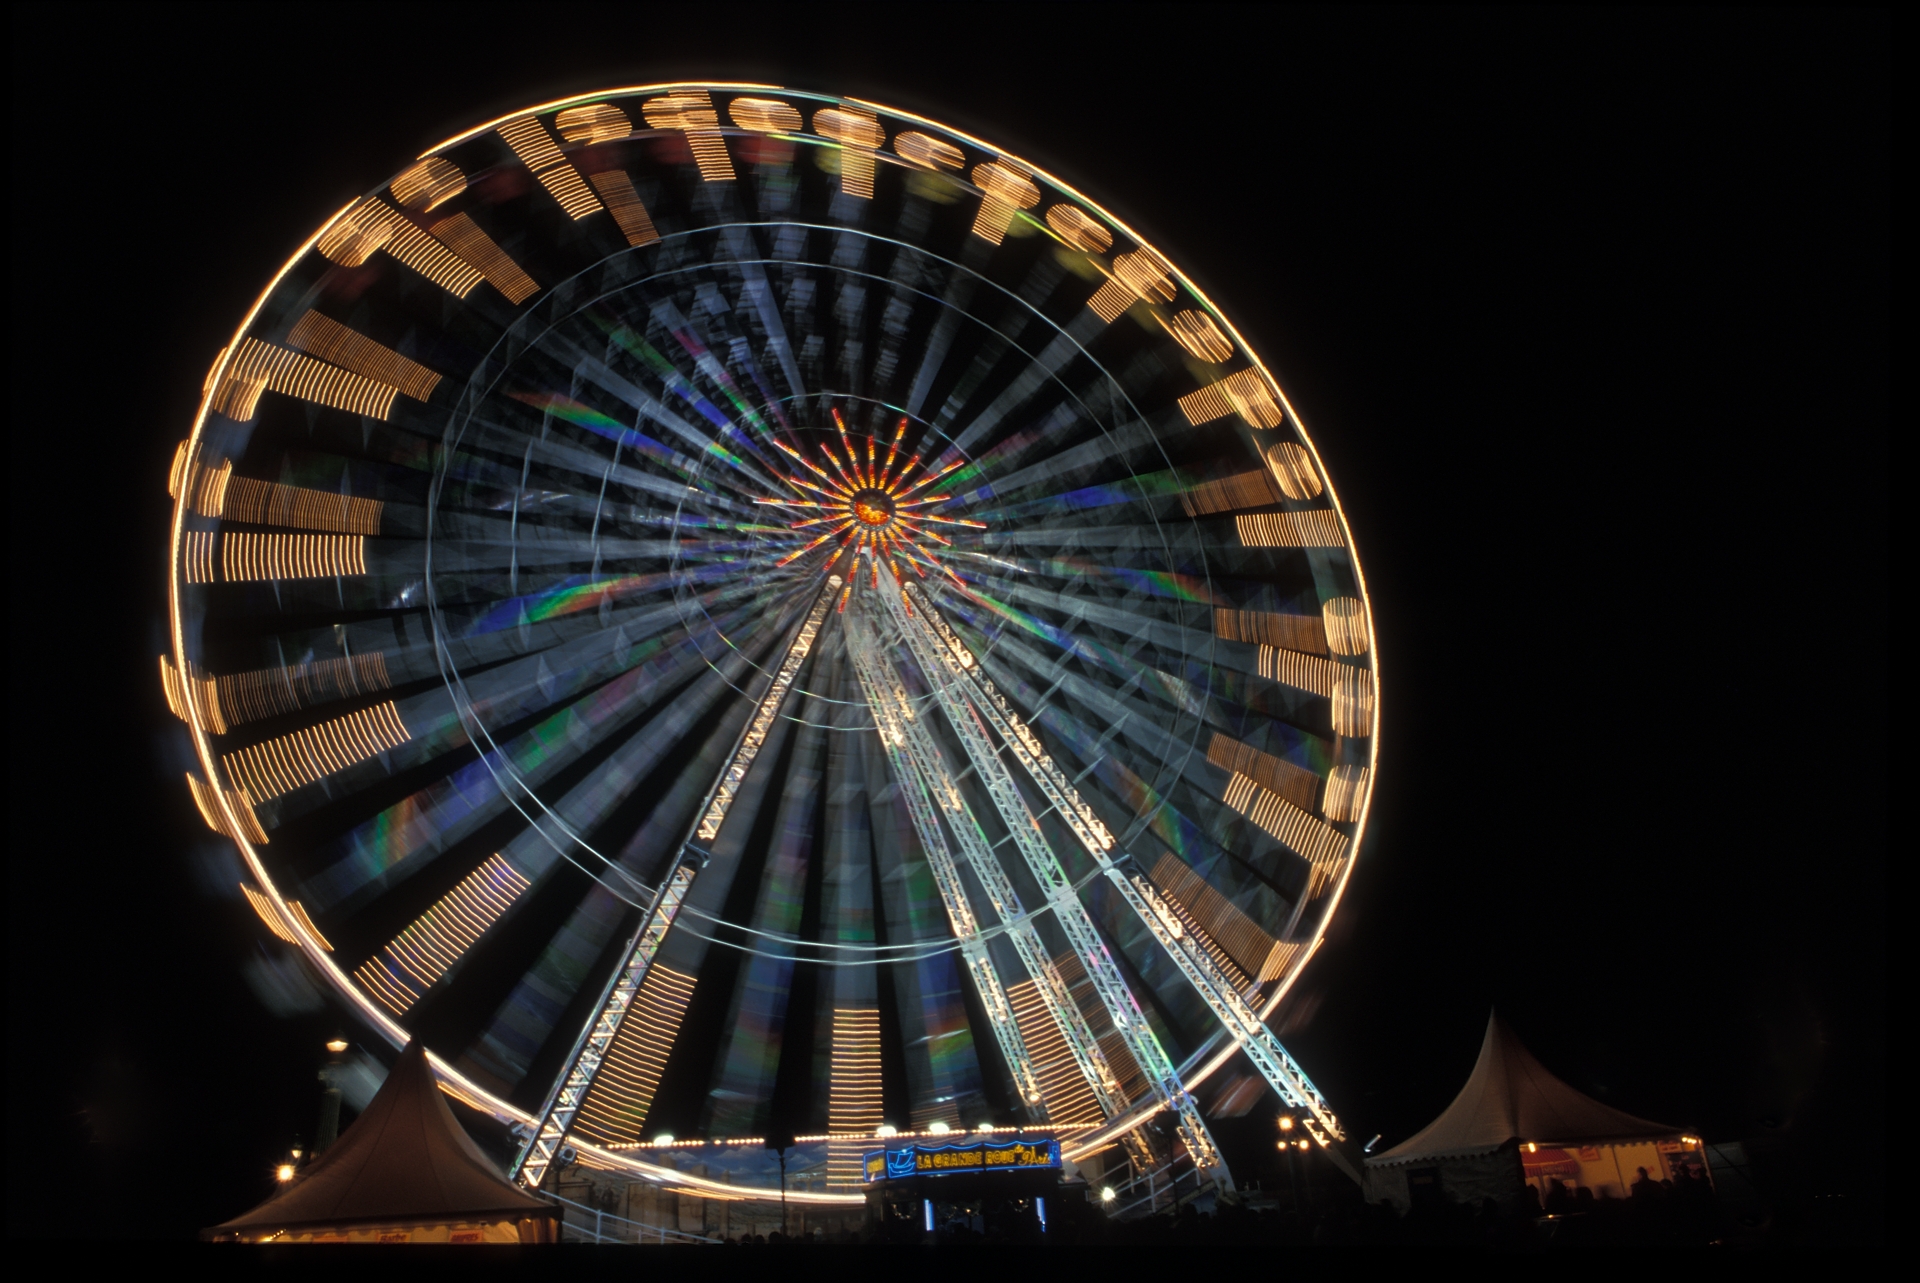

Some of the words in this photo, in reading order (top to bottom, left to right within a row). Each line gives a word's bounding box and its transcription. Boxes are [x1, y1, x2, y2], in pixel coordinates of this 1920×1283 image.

[917, 1155, 932, 1169] LA
[933, 1151, 983, 1167] GRANDE
[986, 1150, 1015, 1165] ROUE
